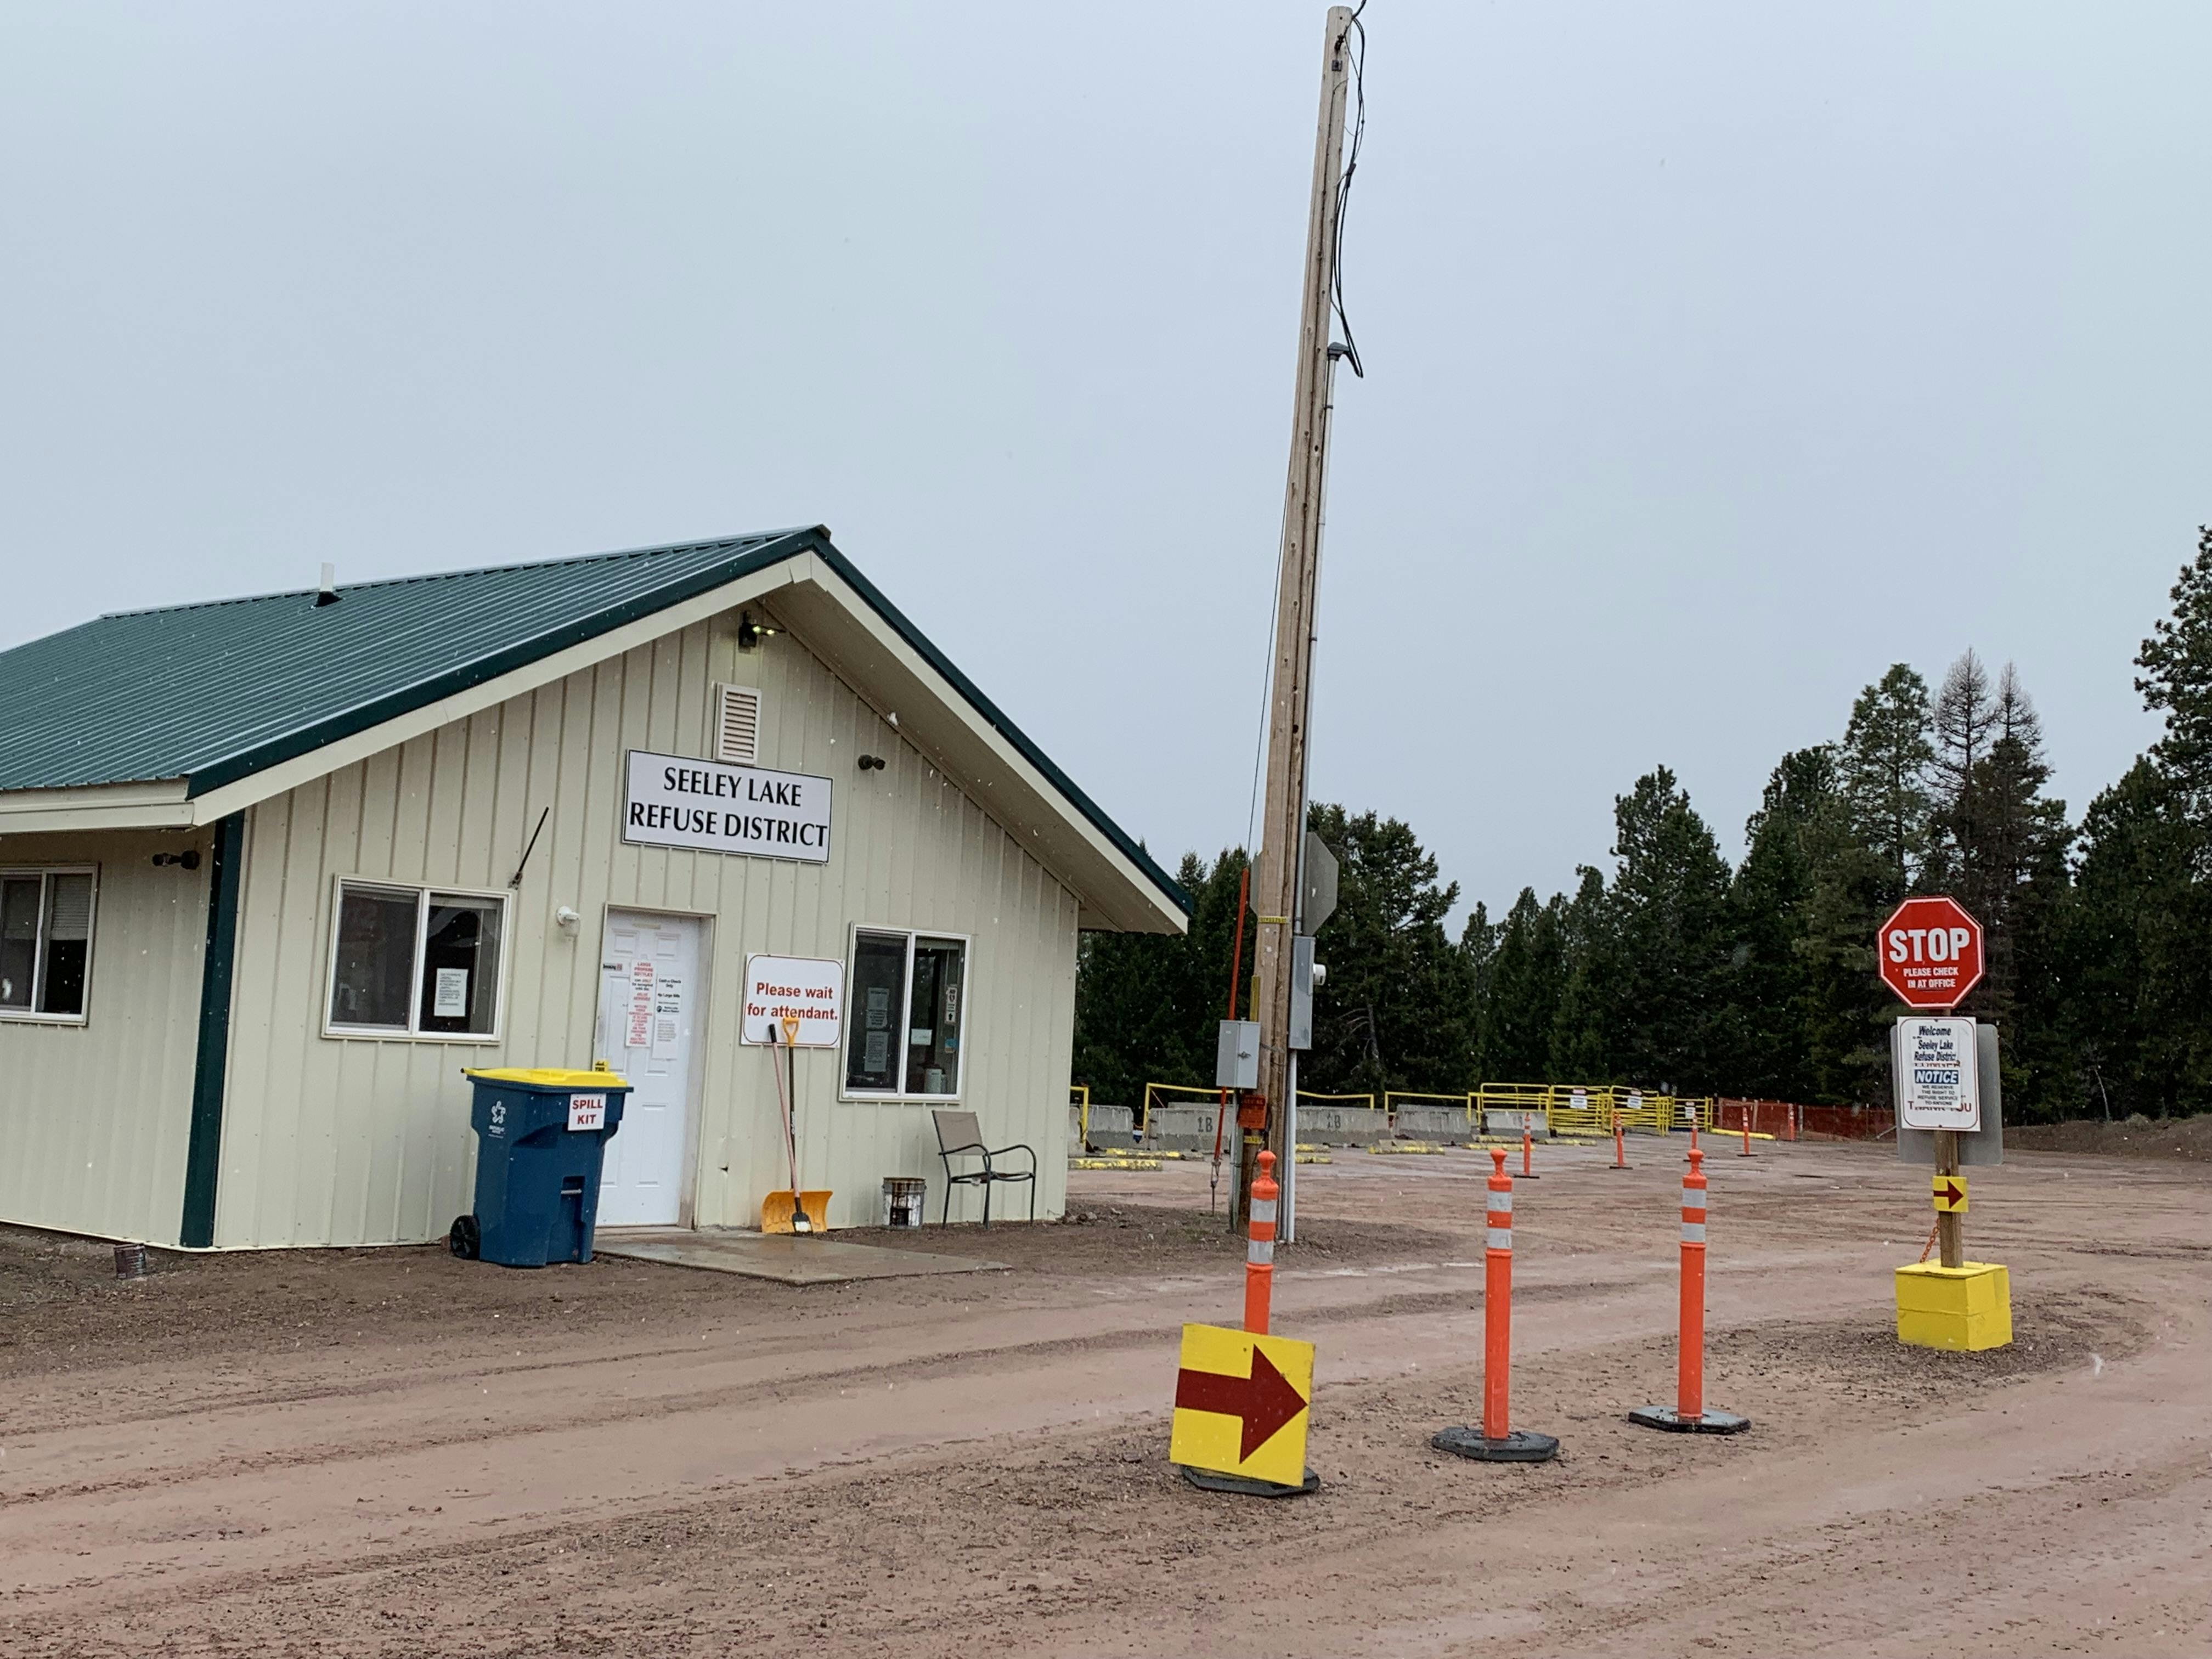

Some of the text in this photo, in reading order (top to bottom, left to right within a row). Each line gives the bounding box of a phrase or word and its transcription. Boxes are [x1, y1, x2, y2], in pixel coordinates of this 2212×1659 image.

[664, 766, 802, 807] SEELEY LAKE
[630, 802, 828, 847] REFUSE DISTRICT
[1889, 927, 1970, 963] STOP
[1903, 967, 1959, 977] PLEASE CHECK
[1908, 979, 1956, 988] IN AT OFFICE
[757, 982, 833, 999] Please wait
[747, 1003, 838, 1020] for attendant.
[1919, 1026, 1951, 1036] Welcome
[1918, 1040, 1953, 1052] Seeley Lake
[1914, 1051, 1934, 1061] Refuse
[1916, 1071, 1957, 1083] NOTICE
[572, 1099, 603, 1109] SPILL
[578, 1114, 596, 1125] KIT
